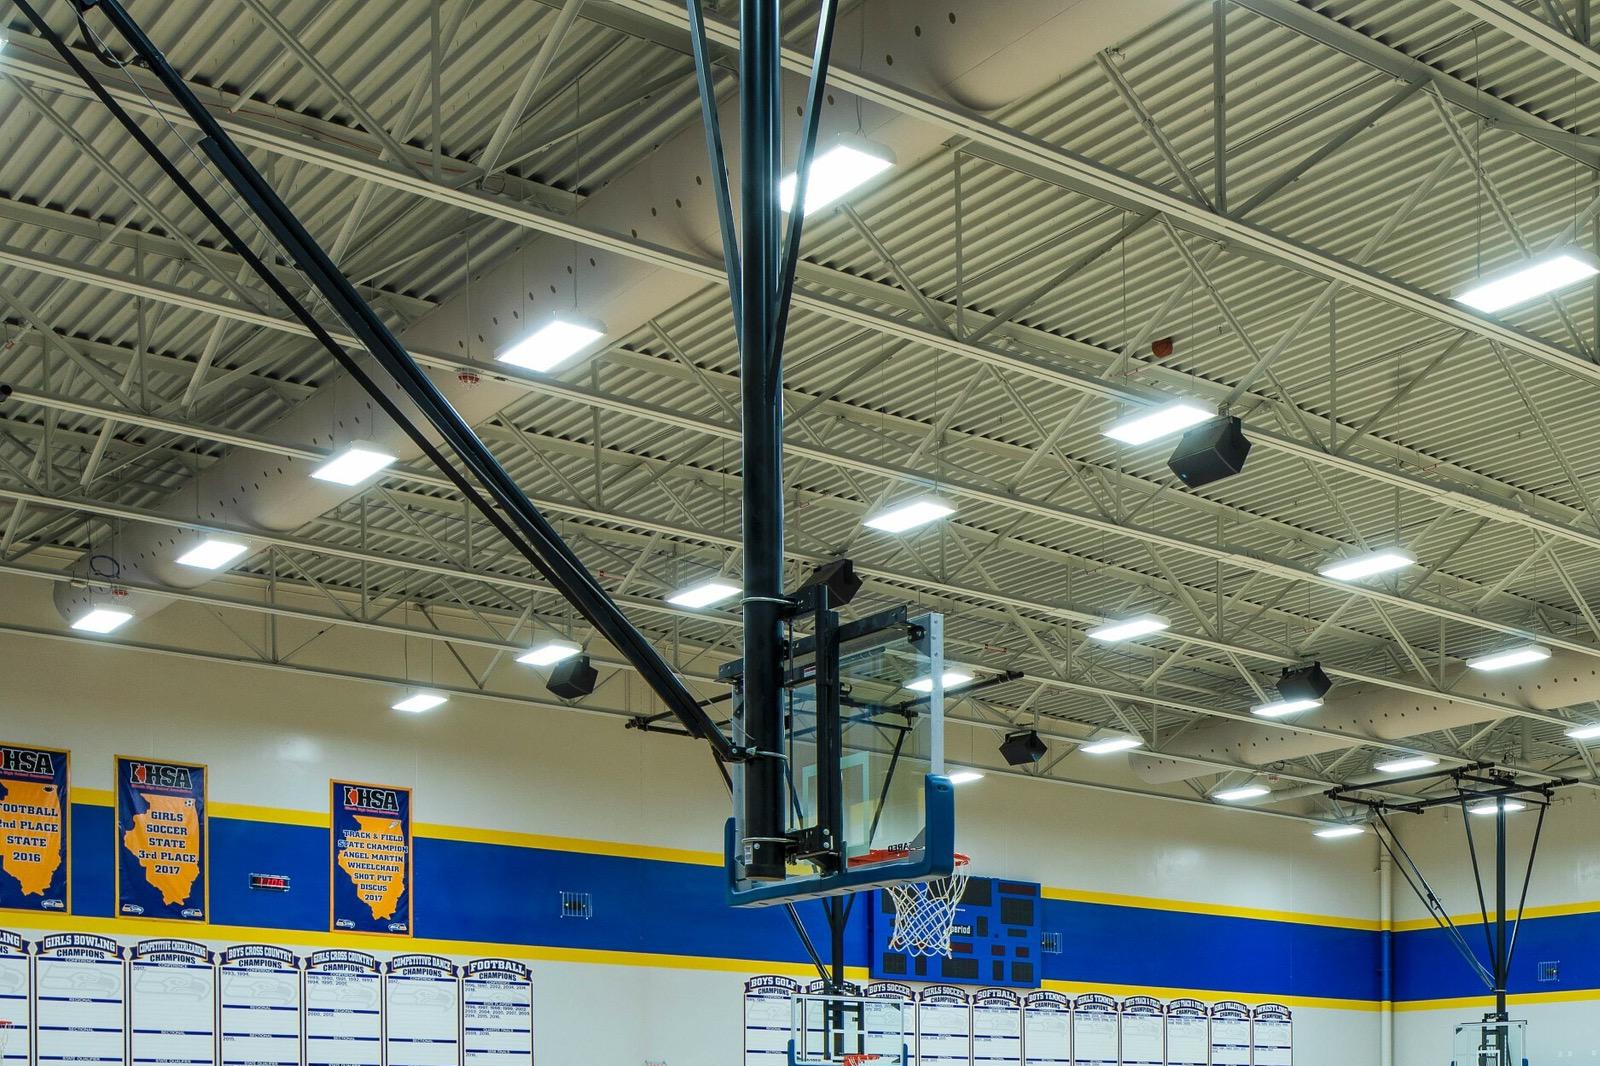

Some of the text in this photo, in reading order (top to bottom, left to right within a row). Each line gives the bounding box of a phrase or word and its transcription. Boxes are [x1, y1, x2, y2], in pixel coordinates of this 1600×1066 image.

[0, 748, 54, 775] HSA
[151, 811, 183, 822] GIRLS
[20, 821, 58, 832] PLACE
[146, 824, 188, 836] SOCCER
[343, 829, 371, 840] TRACK
[381, 833, 403, 842] FIELD
[7, 836, 47, 847] STATE
[149, 837, 186, 849] STATE
[338, 839, 408, 853] STATE CHAMPION
[13, 852, 41, 862] 2016
[139, 850, 196, 863] 3rd PLACE
[343, 851, 403, 863] ANGEL MARTIN
[155, 865, 180, 875] 2017
[348, 861, 400, 873] WHEELCHAIR
[354, 872, 392, 882] SHOT PUT
[360, 883, 387, 891] DISCUS
[364, 894, 383, 902] 2017
[45, 934, 116, 952] GIRLS BOWLING
[56, 948, 105, 959] CHAMPIONS
[228, 946, 292, 960] BOYS CROSS COUNTRY
[313, 950, 373, 966] GIRLS CROSS COUNTRY
[150, 954, 196, 964] CHAMPIONS
[238, 959, 282, 969] CHAMPIONS
[323, 963, 364, 974] CHAMPIONS
[470, 960, 525, 974] FOOTBALL
[403, 968, 442, 978] CHAMPIONS
[479, 972, 517, 981] CHAMPIONS
[750, 976, 796, 990] BOYS GOLF
[757, 988, 789, 996] CHAMPIONS
[869, 983, 910, 995] BOYS SOCCER
[924, 987, 965, 998] GIRLS SOCCER
[977, 989, 1016, 1002] SOFTBALL
[1029, 993, 1044, 1003] BOYS
[983, 999, 1010, 1007] CHAMPIONS
